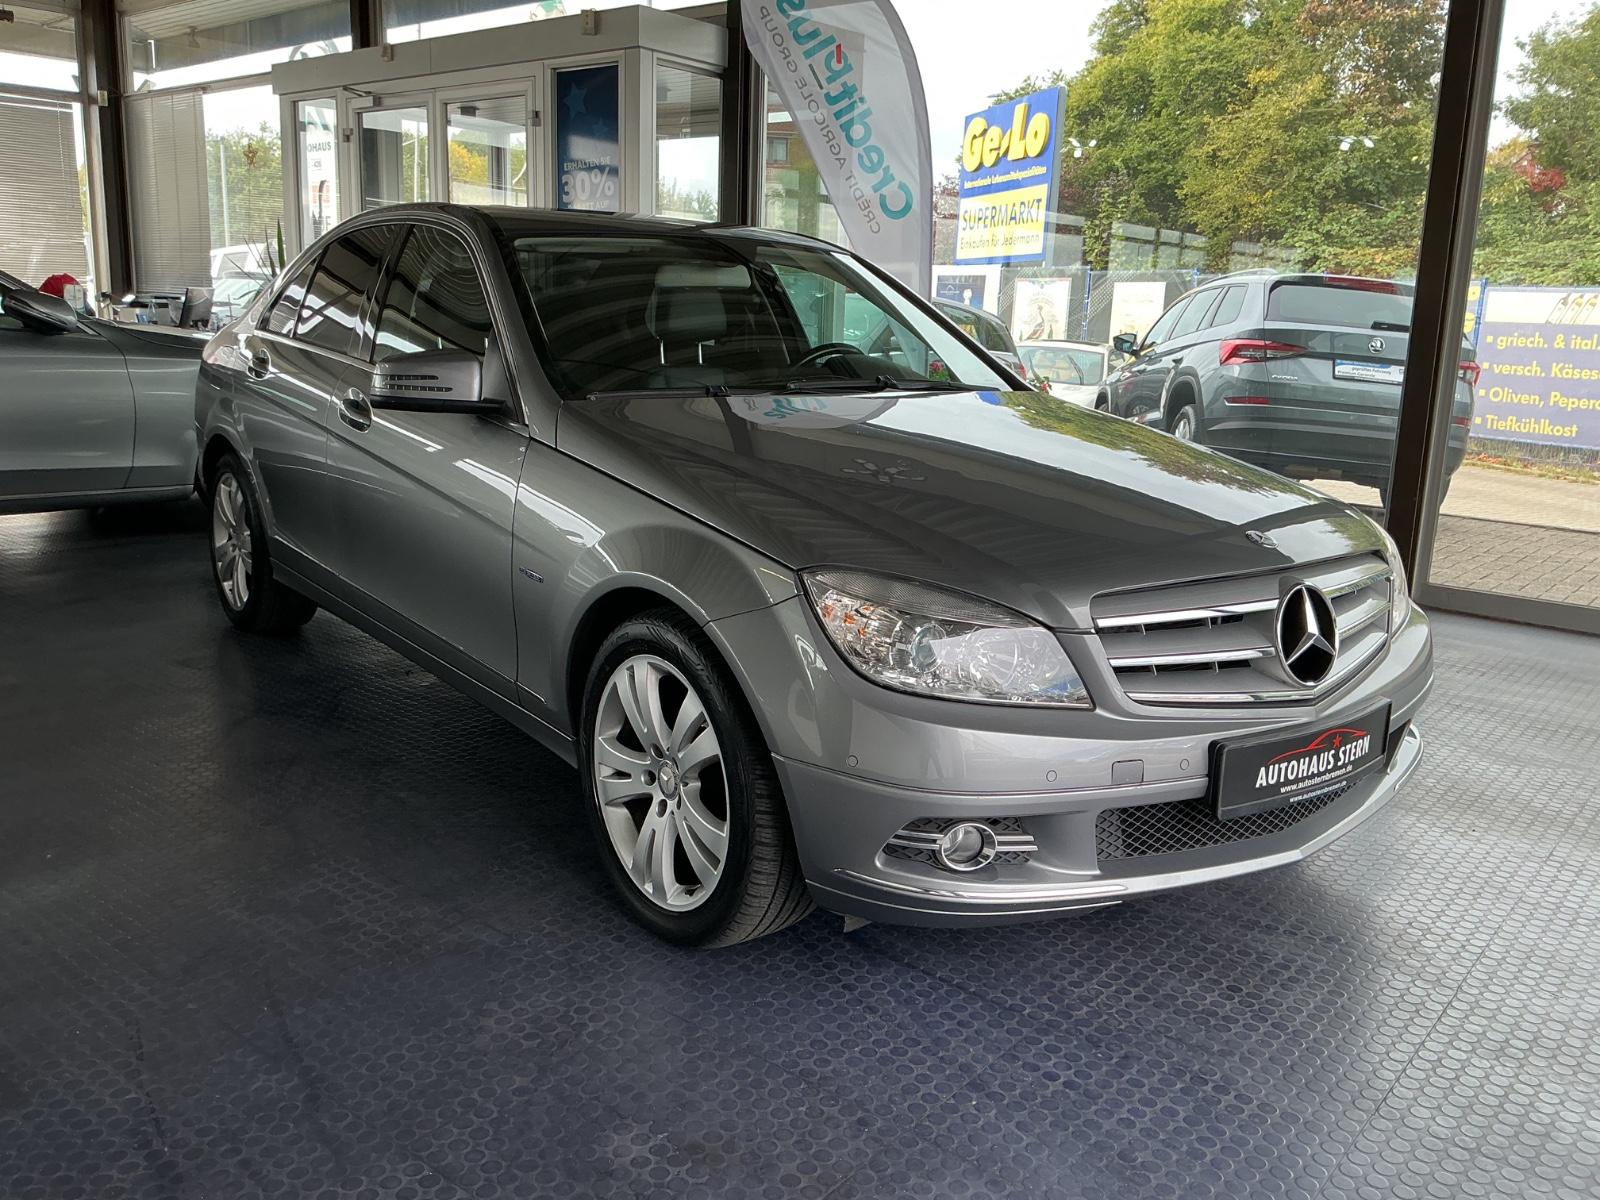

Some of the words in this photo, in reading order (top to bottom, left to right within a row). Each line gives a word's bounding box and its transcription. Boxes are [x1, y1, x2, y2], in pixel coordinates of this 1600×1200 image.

[564, 160, 599, 171] ERHALTEN
[561, 166, 615, 203] 30%
[962, 198, 1042, 231] SUPERMARKT
[960, 234, 989, 249] Einkaufen
[991, 231, 1000, 247] für
[1001, 231, 1040, 246] Jedermann
[1497, 331, 1548, 349] griech.
[1554, 333, 1566, 349] &
[1570, 333, 1600, 350] ital.
[1493, 360, 1545, 377] versch.
[1551, 362, 1600, 380] Käses
[1489, 386, 1544, 408] Oliven,
[1485, 414, 1578, 437] Tiefkühlkost
[1255, 749, 1335, 788] AUTOHAUS
[1338, 735, 1370, 766] STERN
[1280, 764, 1352, 793] www.autosternbremen.de
